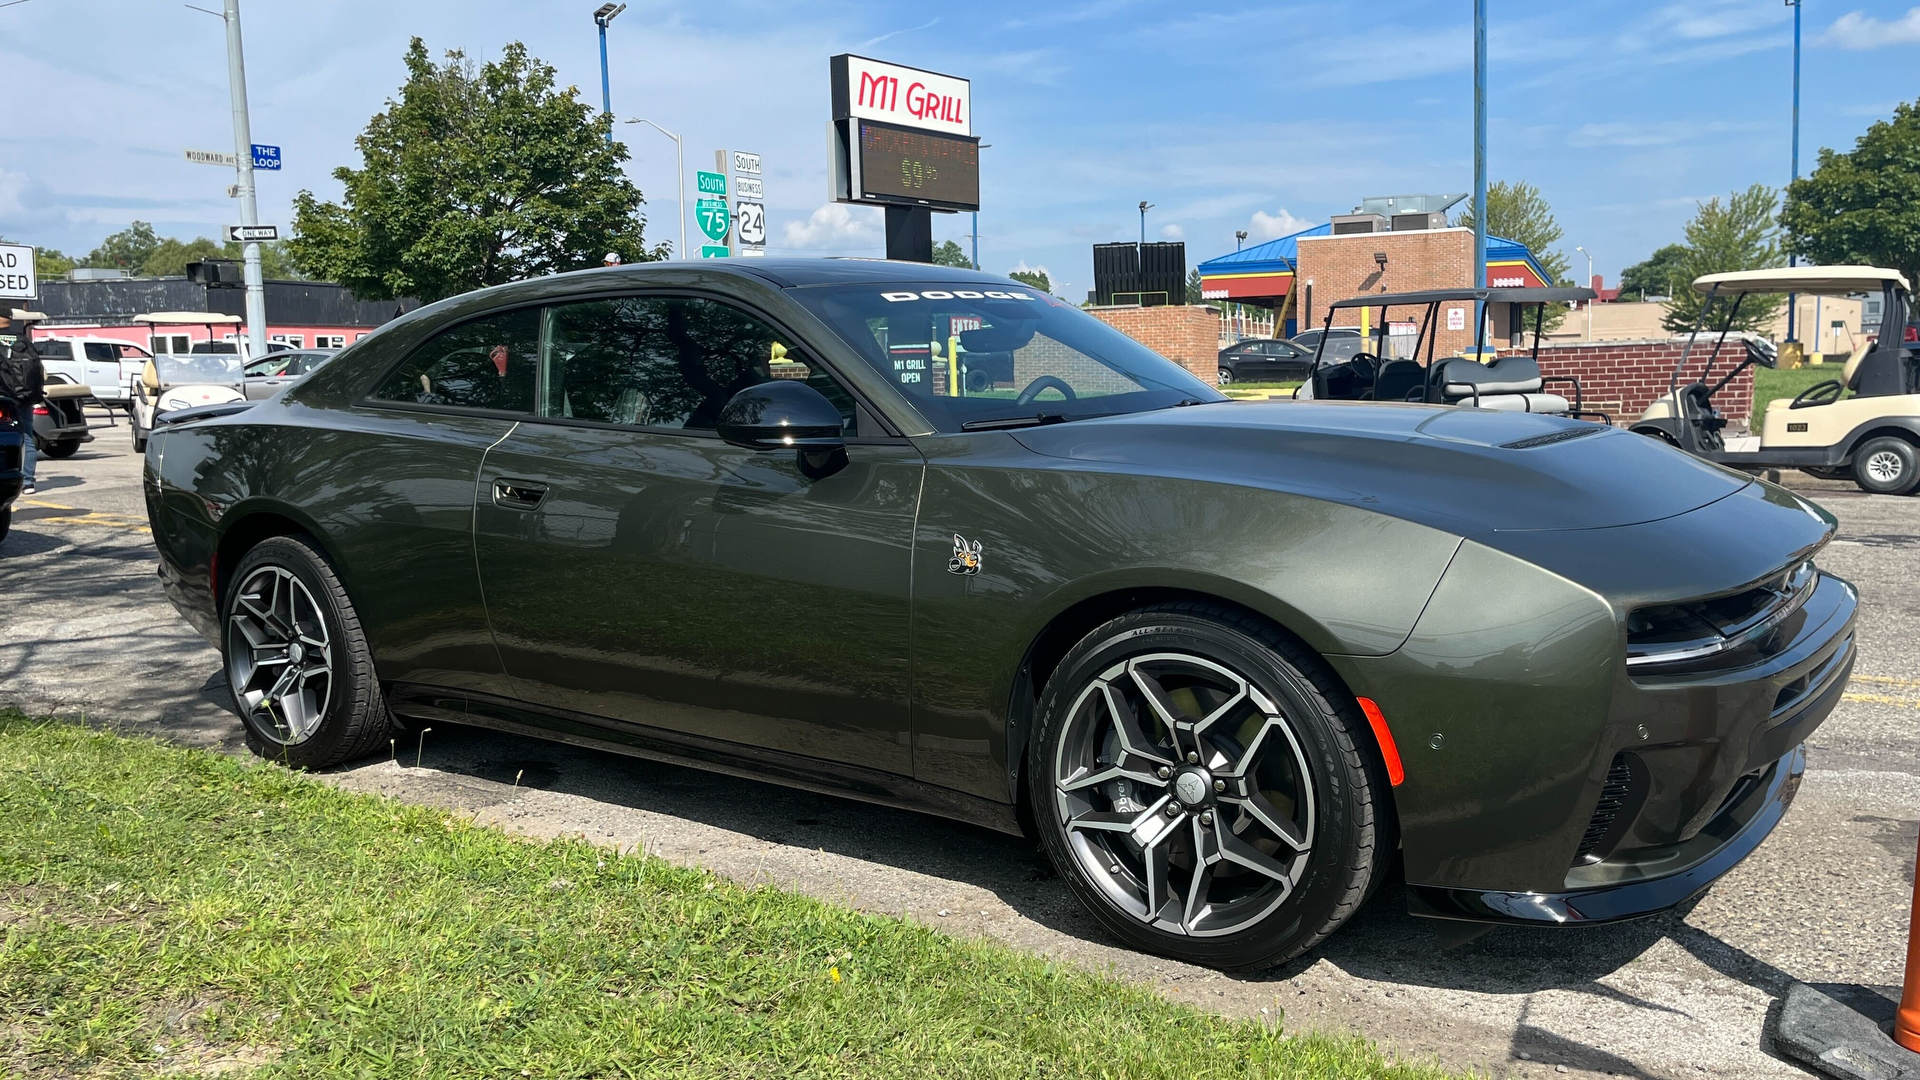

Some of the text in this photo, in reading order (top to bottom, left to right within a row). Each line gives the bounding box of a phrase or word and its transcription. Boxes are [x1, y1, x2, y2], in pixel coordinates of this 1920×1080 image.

[186, 151, 223, 163] WOODWARD
[255, 146, 276, 156] THE
[253, 158, 280, 168] LOOP
[735, 155, 760, 171] SOUTH
[700, 174, 724, 191] SOUTH
[738, 182, 761, 194] BUSINESS
[702, 211, 725, 232] 75
[741, 211, 763, 234] 24
[881, 291, 1035, 302] DODGE
[906, 360, 926, 369] GRILL
[901, 373, 921, 383] OPEN
